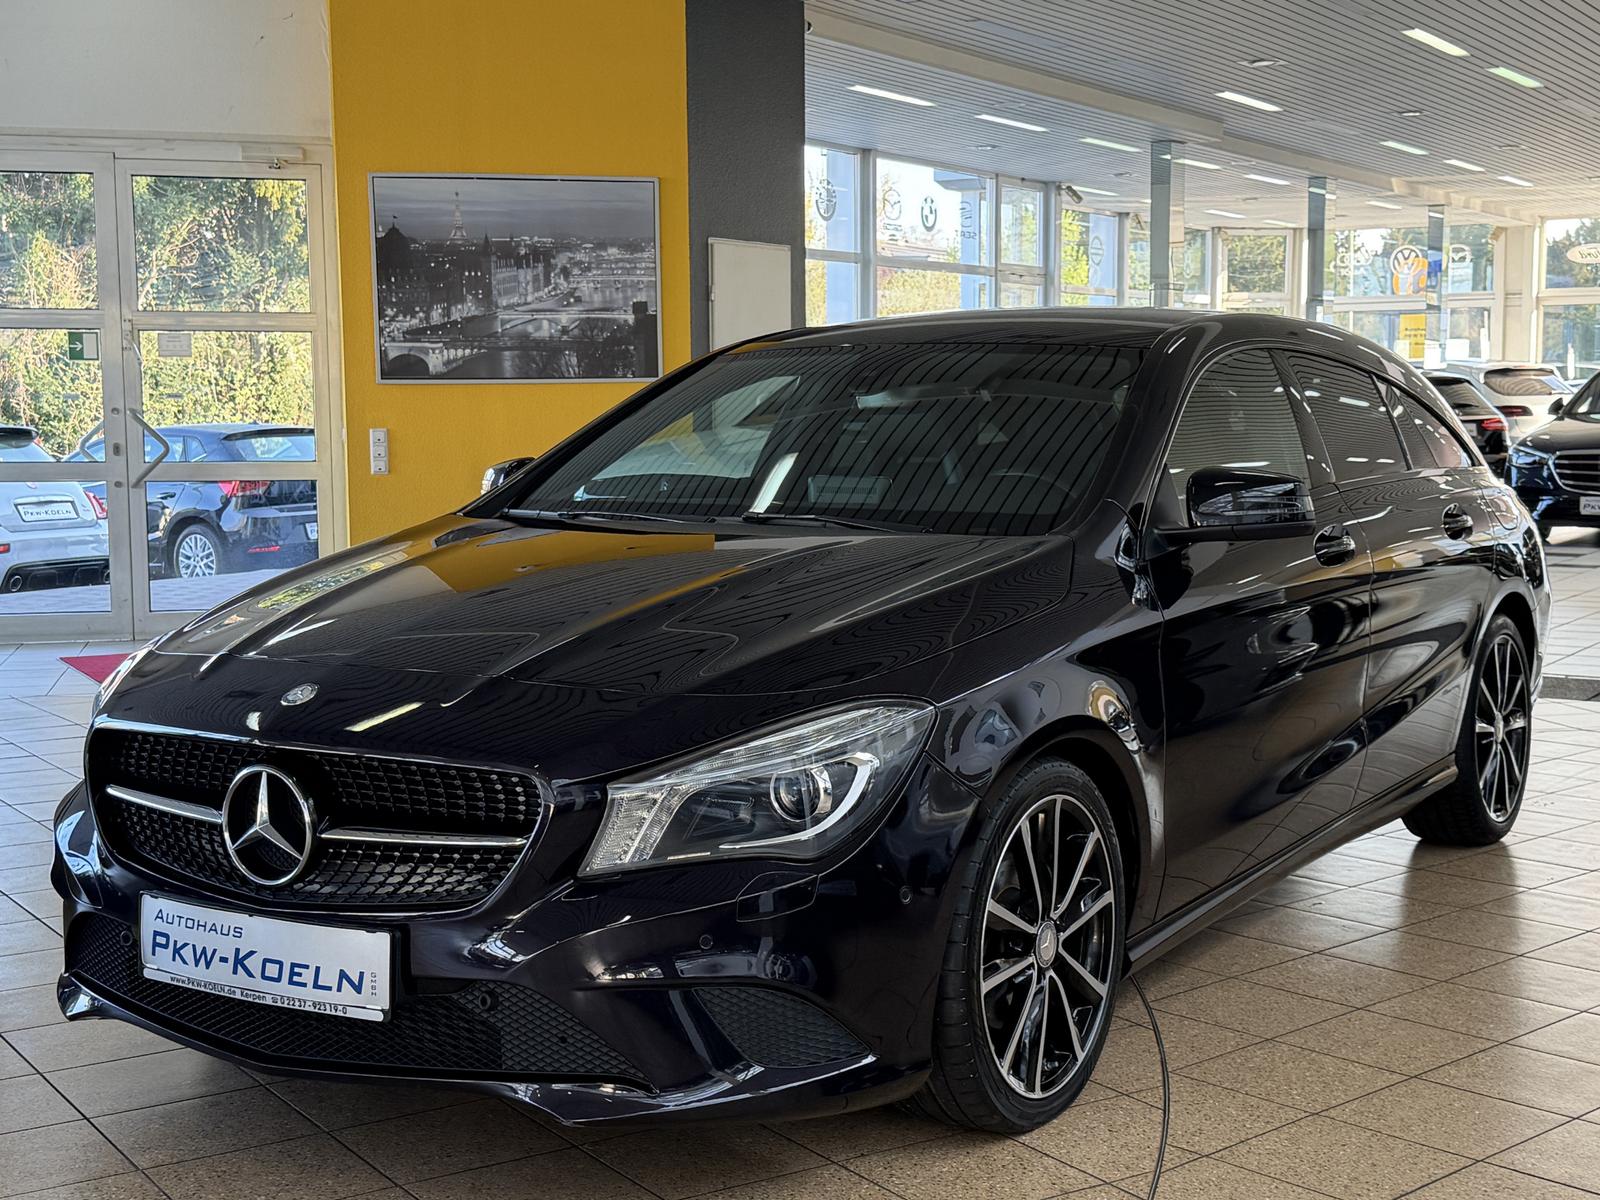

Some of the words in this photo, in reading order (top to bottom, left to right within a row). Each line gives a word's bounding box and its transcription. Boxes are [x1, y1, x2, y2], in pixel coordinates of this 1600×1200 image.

[154, 908, 243, 939] AUTOHAUS
[151, 930, 365, 995] PKW-KOELN
[240, 989, 268, 1002] Kerpen
